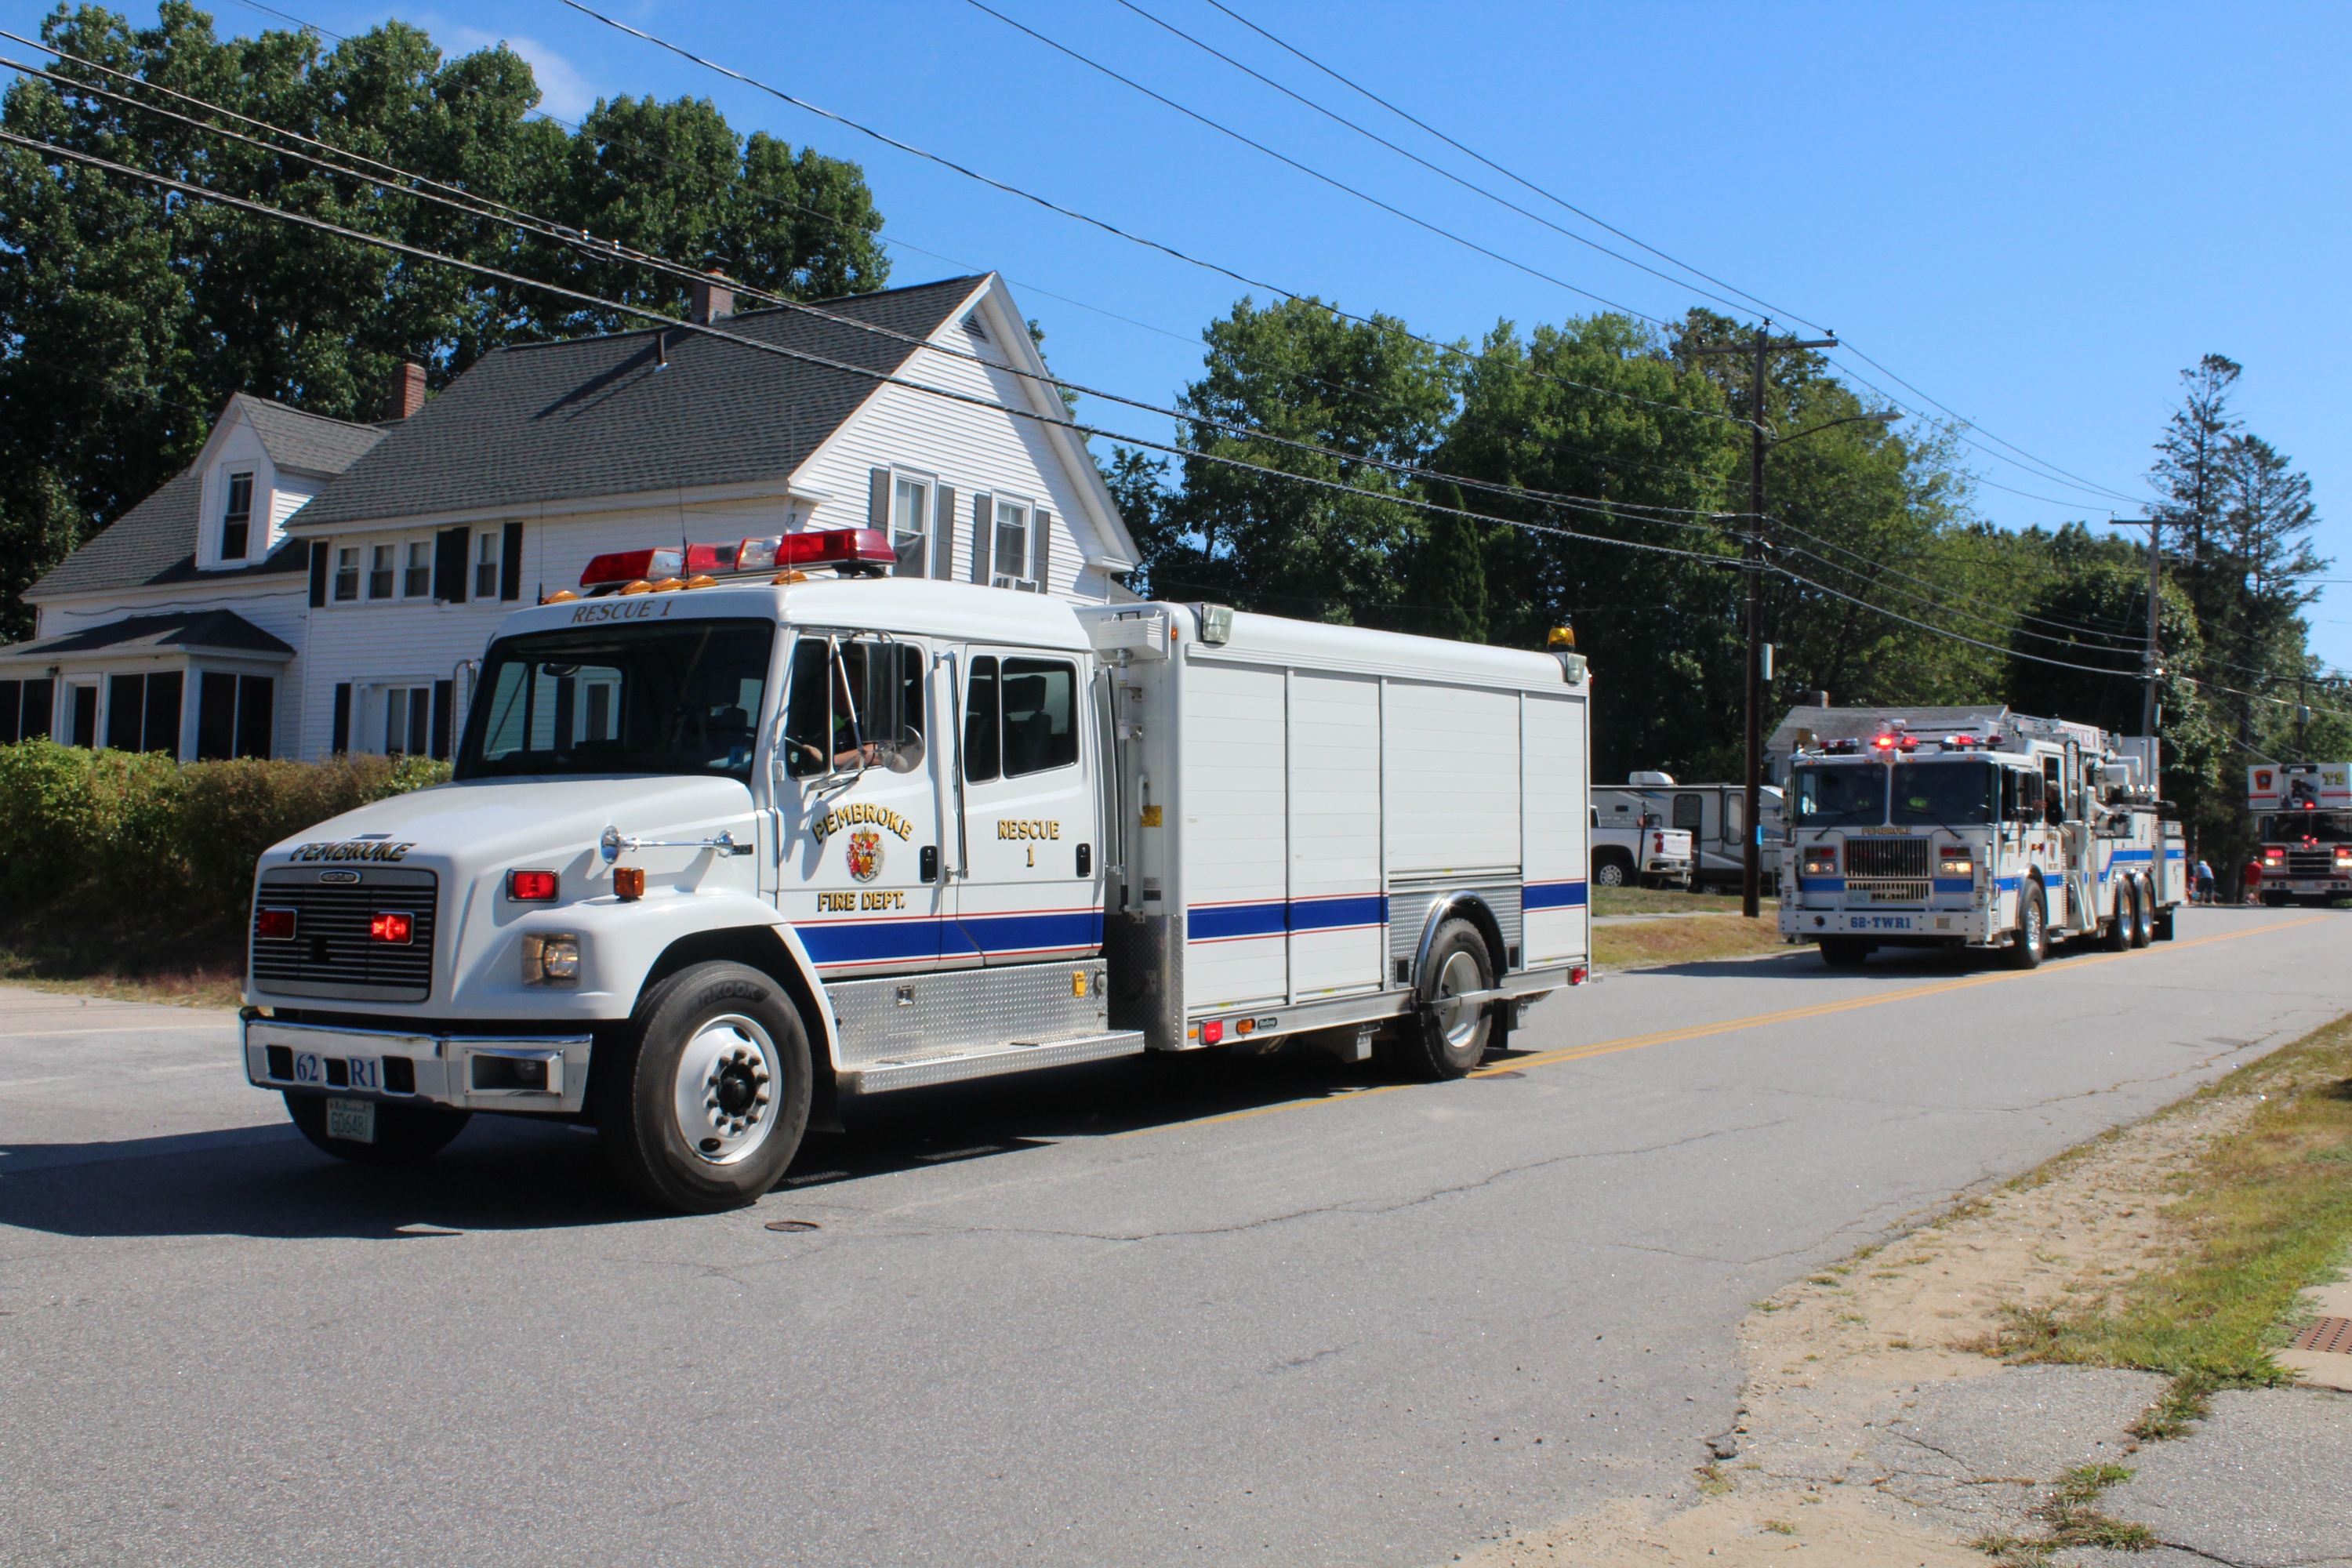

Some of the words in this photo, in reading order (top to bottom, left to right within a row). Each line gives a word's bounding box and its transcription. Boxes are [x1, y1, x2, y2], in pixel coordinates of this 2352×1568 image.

[572, 600, 655, 624] RESCUE
[659, 599, 673, 617] 1
[812, 803, 914, 845] PEMBROKE
[997, 819, 1060, 840] RESCUE
[289, 841, 417, 862] PEMBROKE
[1025, 843, 1035, 868] 1
[817, 892, 857, 913] FIRE
[861, 891, 907, 910] DEPT.
[1850, 916, 1911, 929] 62-TWR1
[296, 1053, 319, 1082] 62
[350, 1058, 378, 1088] R1
